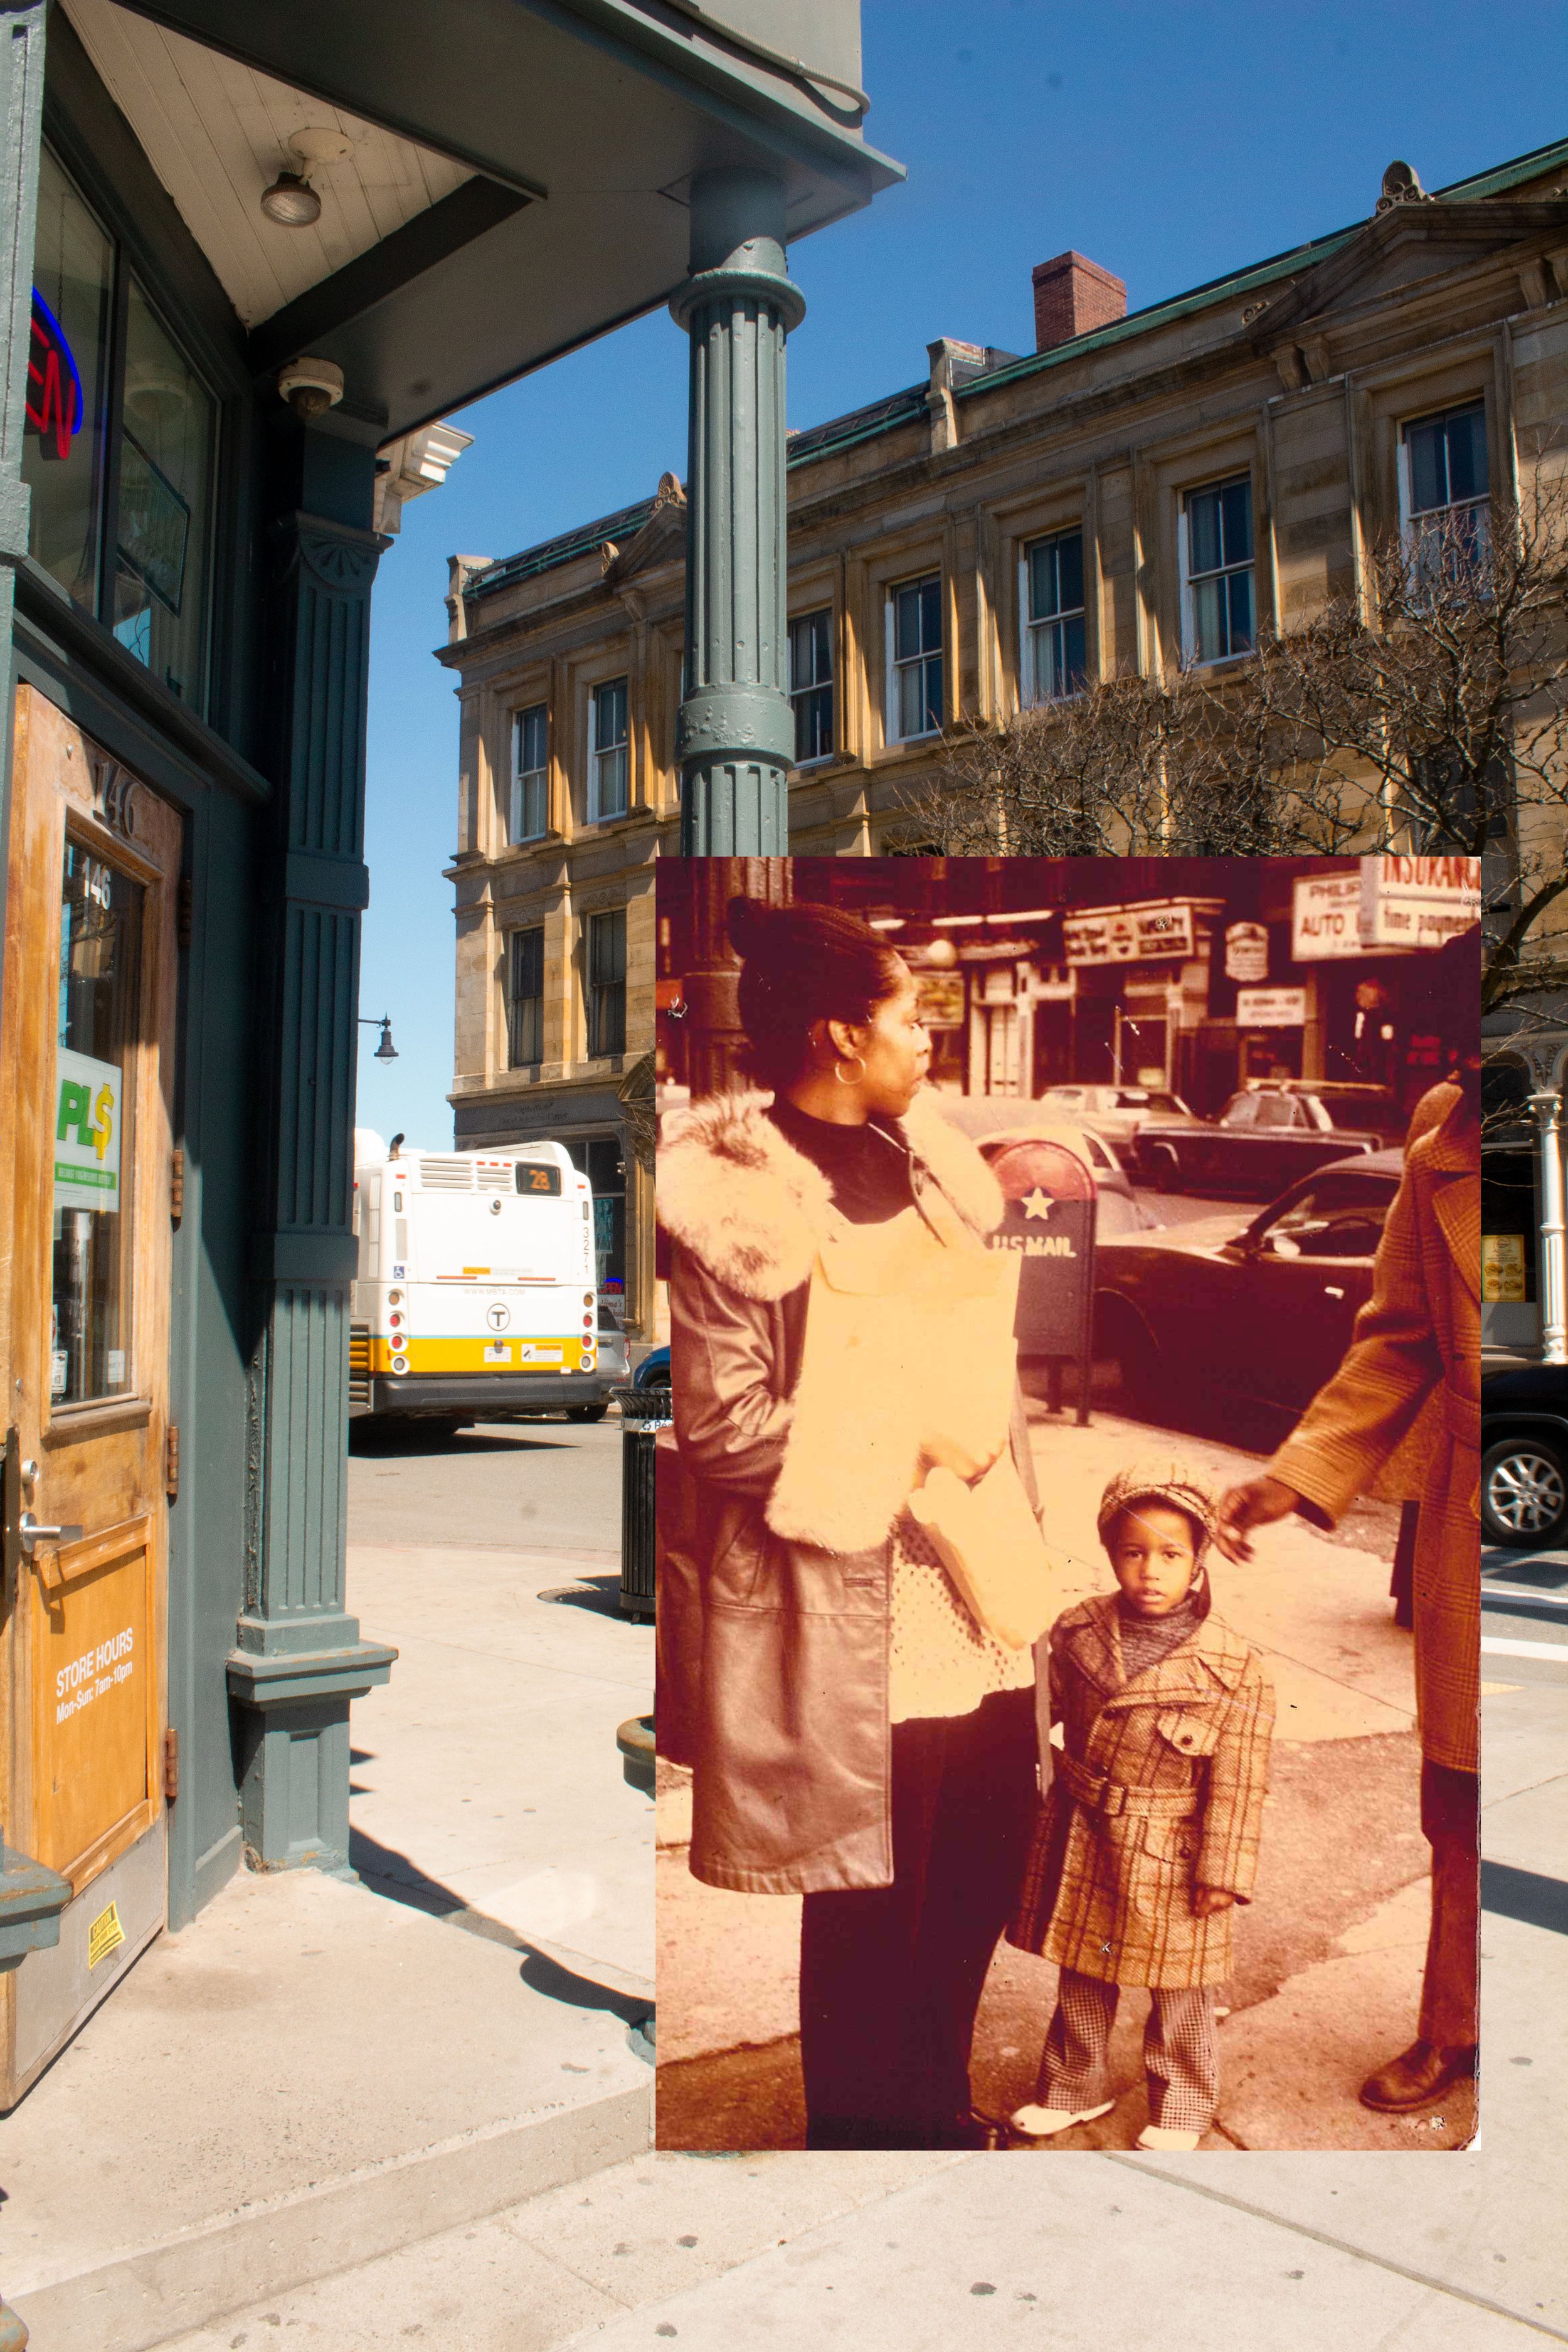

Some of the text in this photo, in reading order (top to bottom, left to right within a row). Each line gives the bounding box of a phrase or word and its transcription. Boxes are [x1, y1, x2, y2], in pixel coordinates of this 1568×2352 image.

[82, 857, 111, 910] 146
[1301, 913, 1344, 936] AUTO
[1025, 1236, 1077, 1258] MAIL
[491, 1311, 506, 1327] T
[56, 1627, 134, 1697] STORE HOURS
[56, 1661, 133, 1725] Mon-Sun: 7am-10pm
